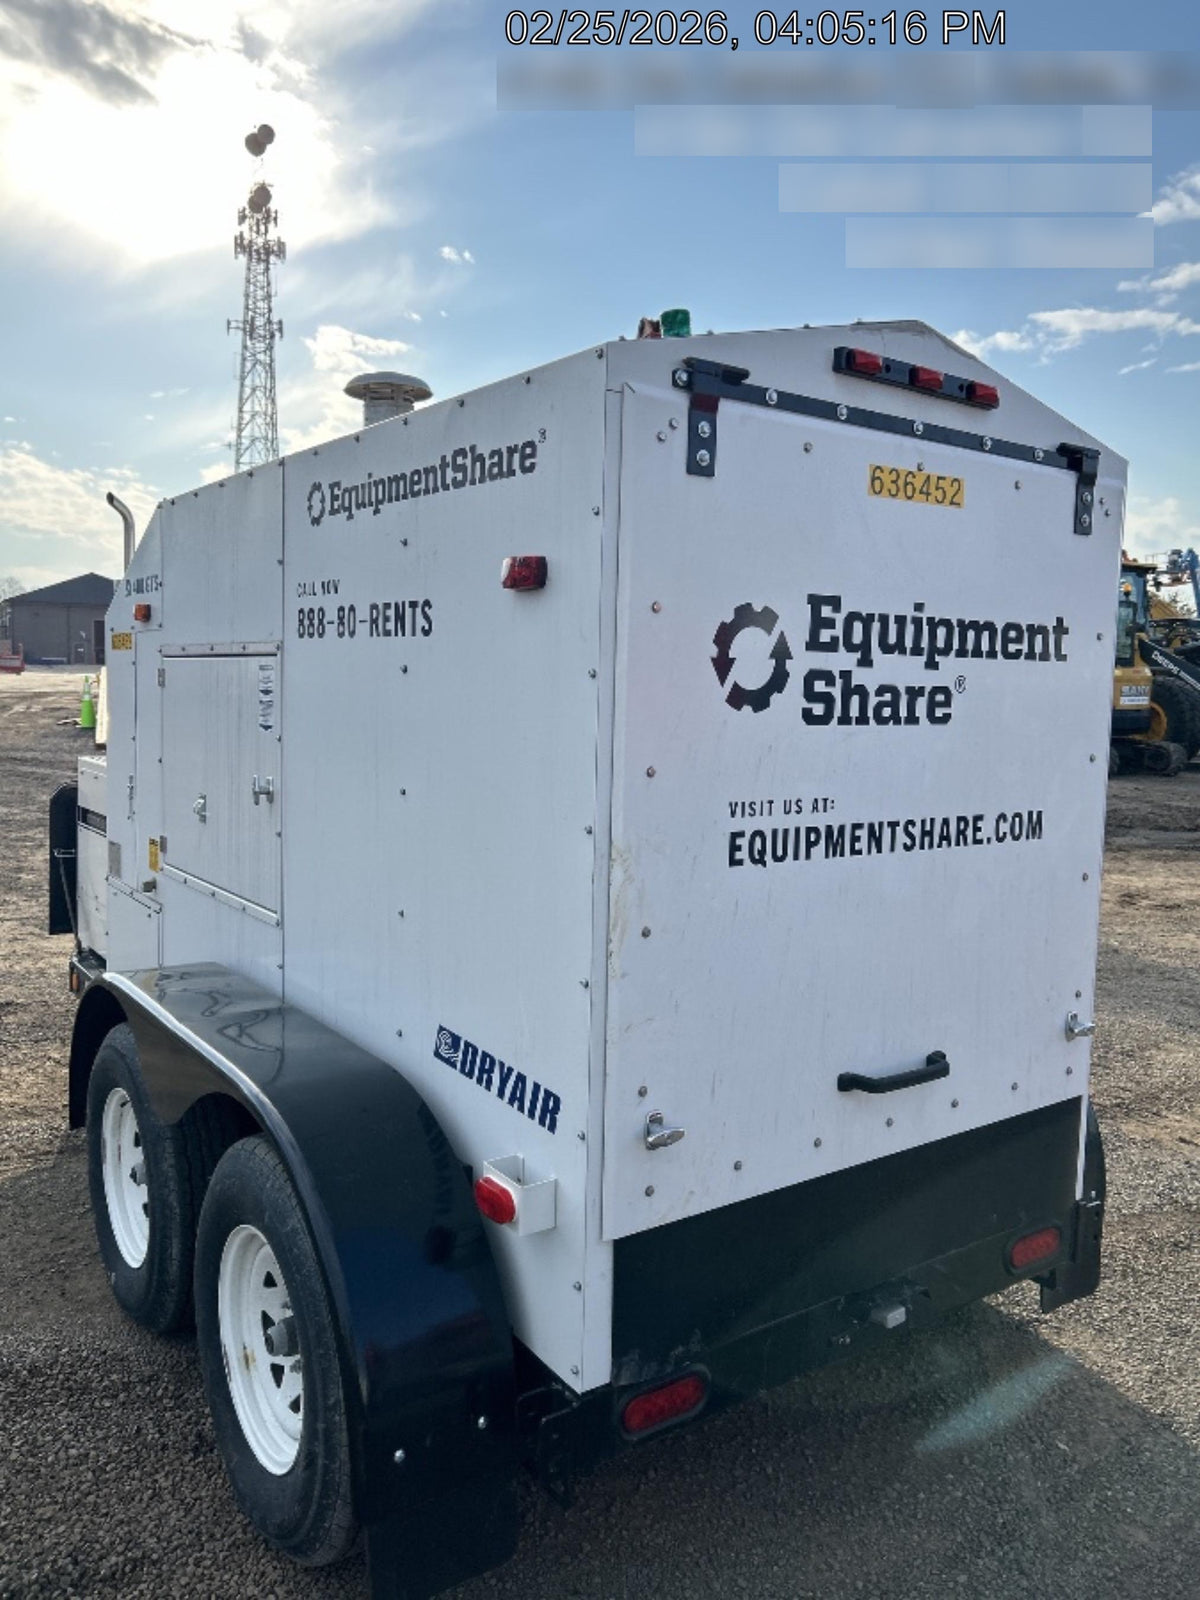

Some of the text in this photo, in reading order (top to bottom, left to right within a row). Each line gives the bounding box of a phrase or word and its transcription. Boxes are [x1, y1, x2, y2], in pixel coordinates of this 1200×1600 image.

[870, 465, 961, 506] 636452
[296, 579, 341, 598] CALL NOW
[297, 598, 433, 639] 888-80-RENTS
[804, 593, 1070, 670] Equipment
[728, 797, 836, 819] VISIT US AT:
[727, 810, 1044, 868] EQUIPMENTSHARE.COM
[459, 1039, 562, 1135] DRYAIR
